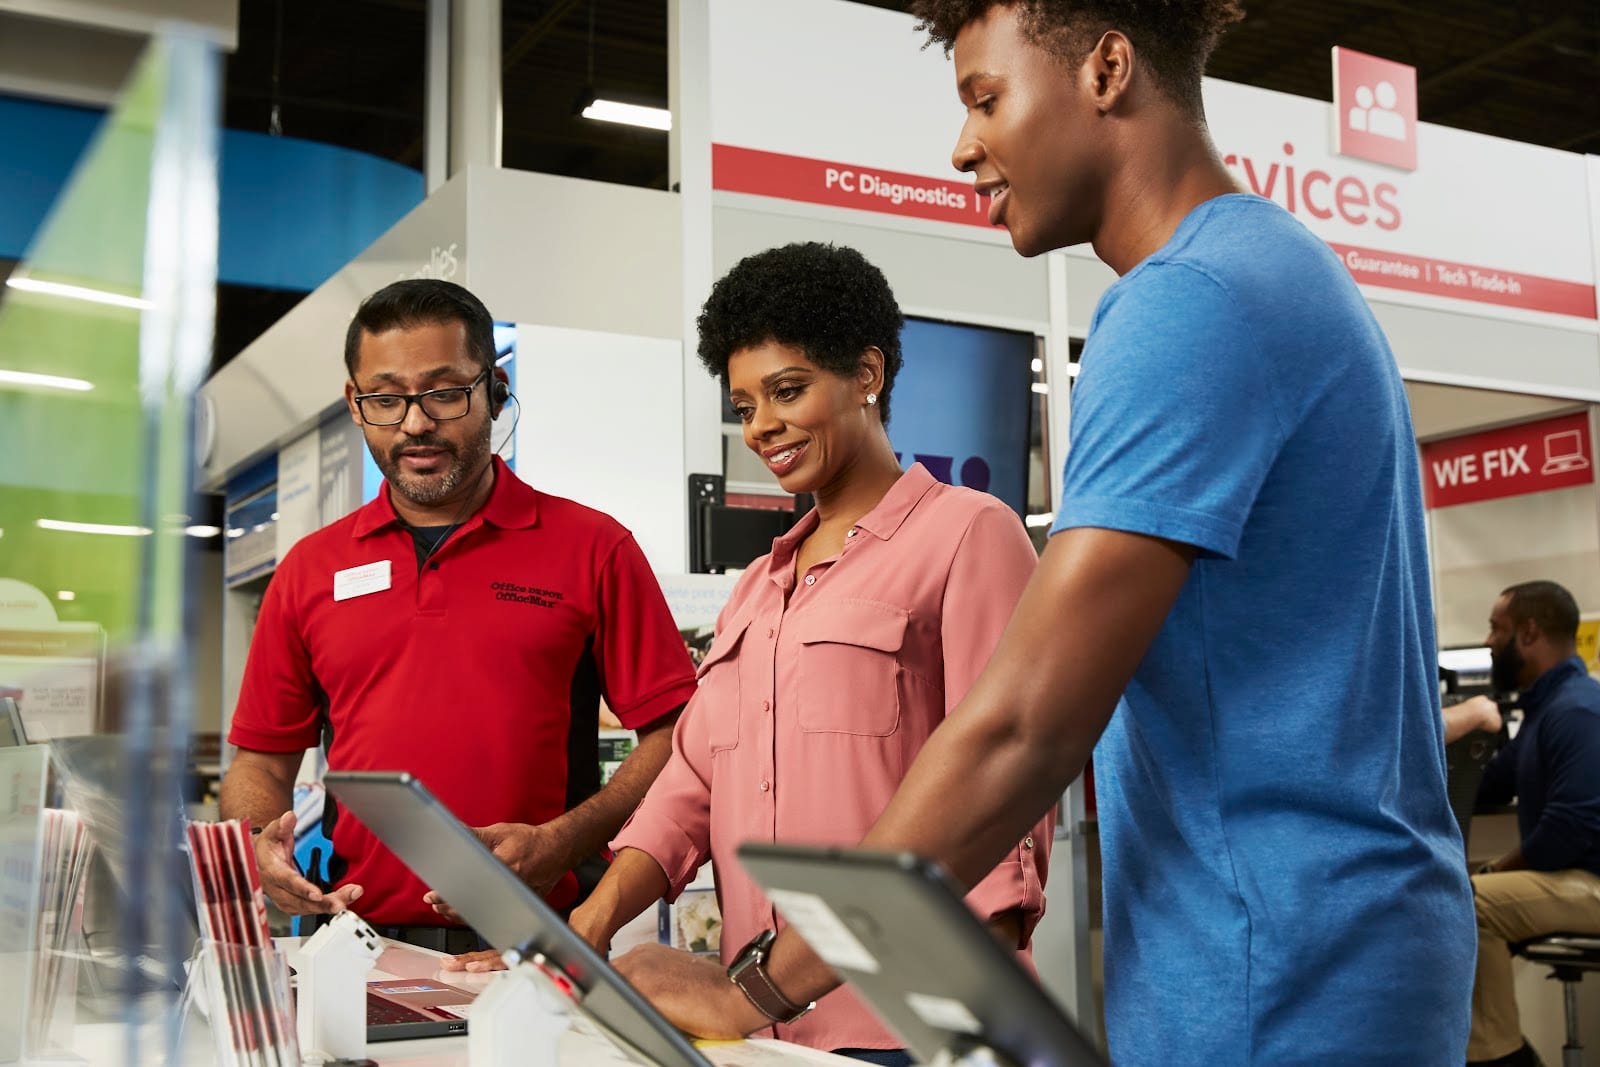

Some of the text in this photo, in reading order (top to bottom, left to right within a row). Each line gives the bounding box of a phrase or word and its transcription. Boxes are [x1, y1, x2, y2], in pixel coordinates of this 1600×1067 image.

[825, 167, 967, 209] PC Diagnostics
[1346, 250, 1419, 279] Guarantee
[1436, 264, 1468, 287] Tech
[1432, 444, 1531, 488] WE FIX
[490, 581, 527, 593] Office
